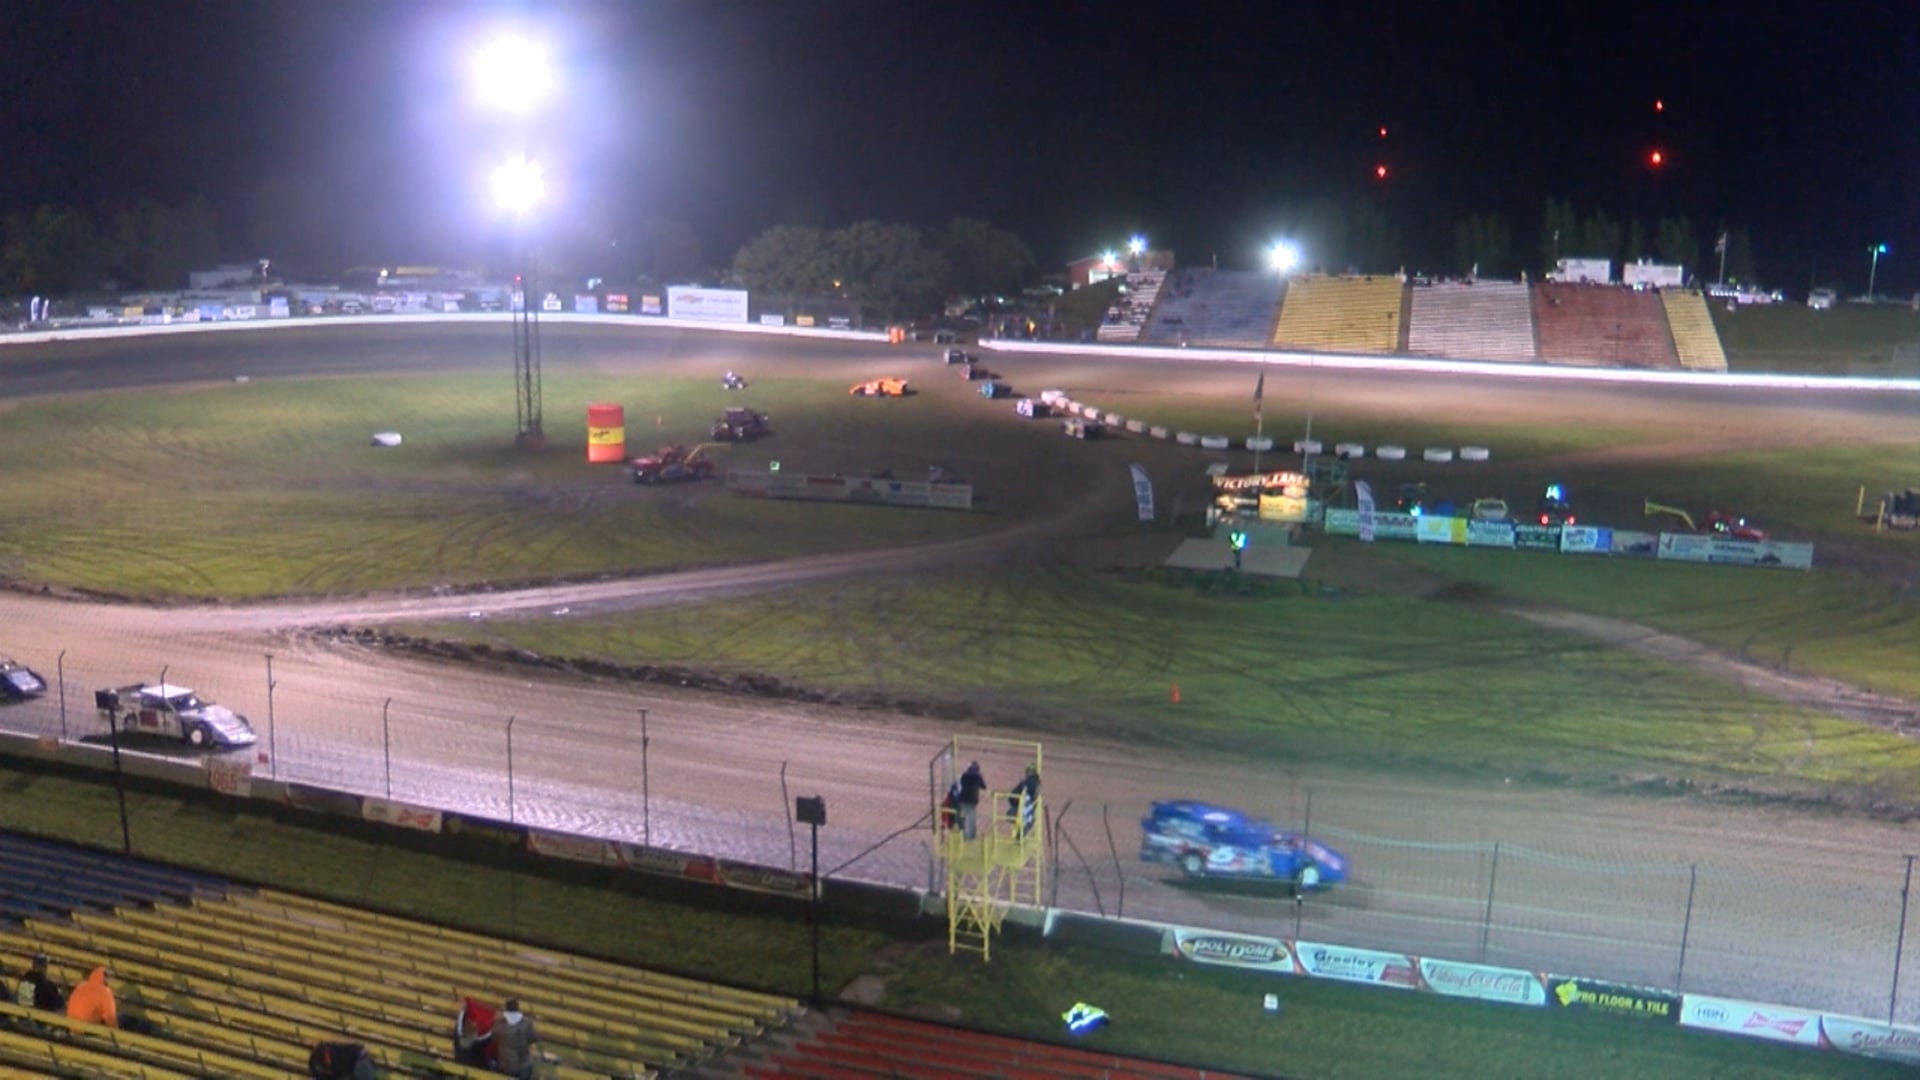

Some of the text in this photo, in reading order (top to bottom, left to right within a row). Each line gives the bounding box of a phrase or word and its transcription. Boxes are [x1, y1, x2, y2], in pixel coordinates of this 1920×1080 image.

[1216, 475, 1267, 489] VICTORY
[1313, 949, 1376, 968] Greeley
[1598, 993, 1633, 1010] FLOOR
[1634, 999, 1644, 1011] &
[1646, 1000, 1670, 1016] TILE
